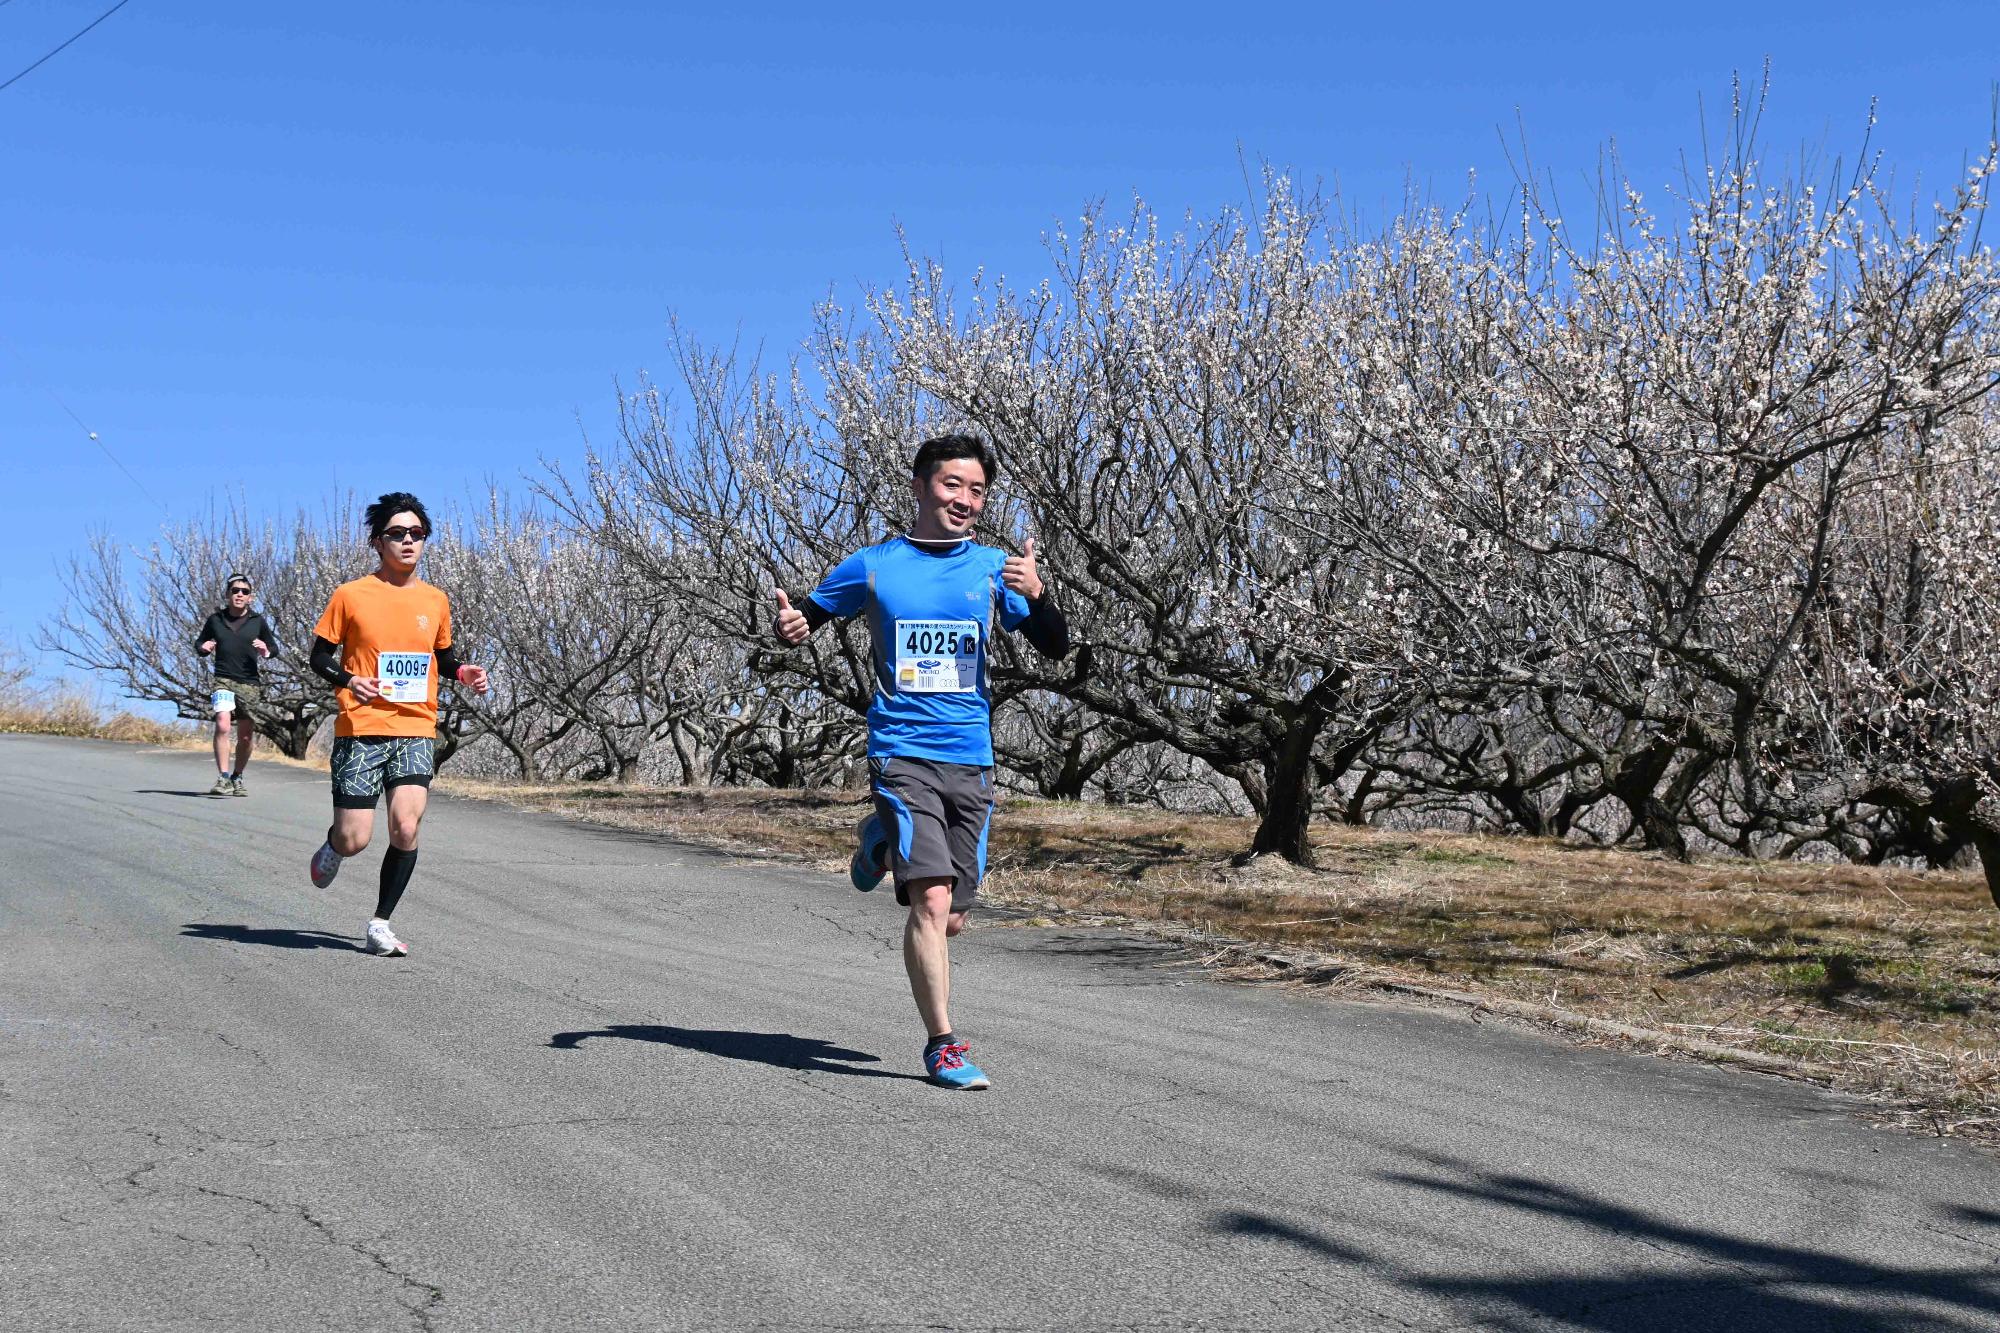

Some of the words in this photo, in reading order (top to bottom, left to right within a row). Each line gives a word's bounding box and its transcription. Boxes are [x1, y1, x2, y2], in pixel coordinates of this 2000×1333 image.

[906, 631, 958, 655] 4025
[965, 640, 975, 652] K
[386, 660, 419, 676] 4009
[943, 663, 975, 672] メイコー
